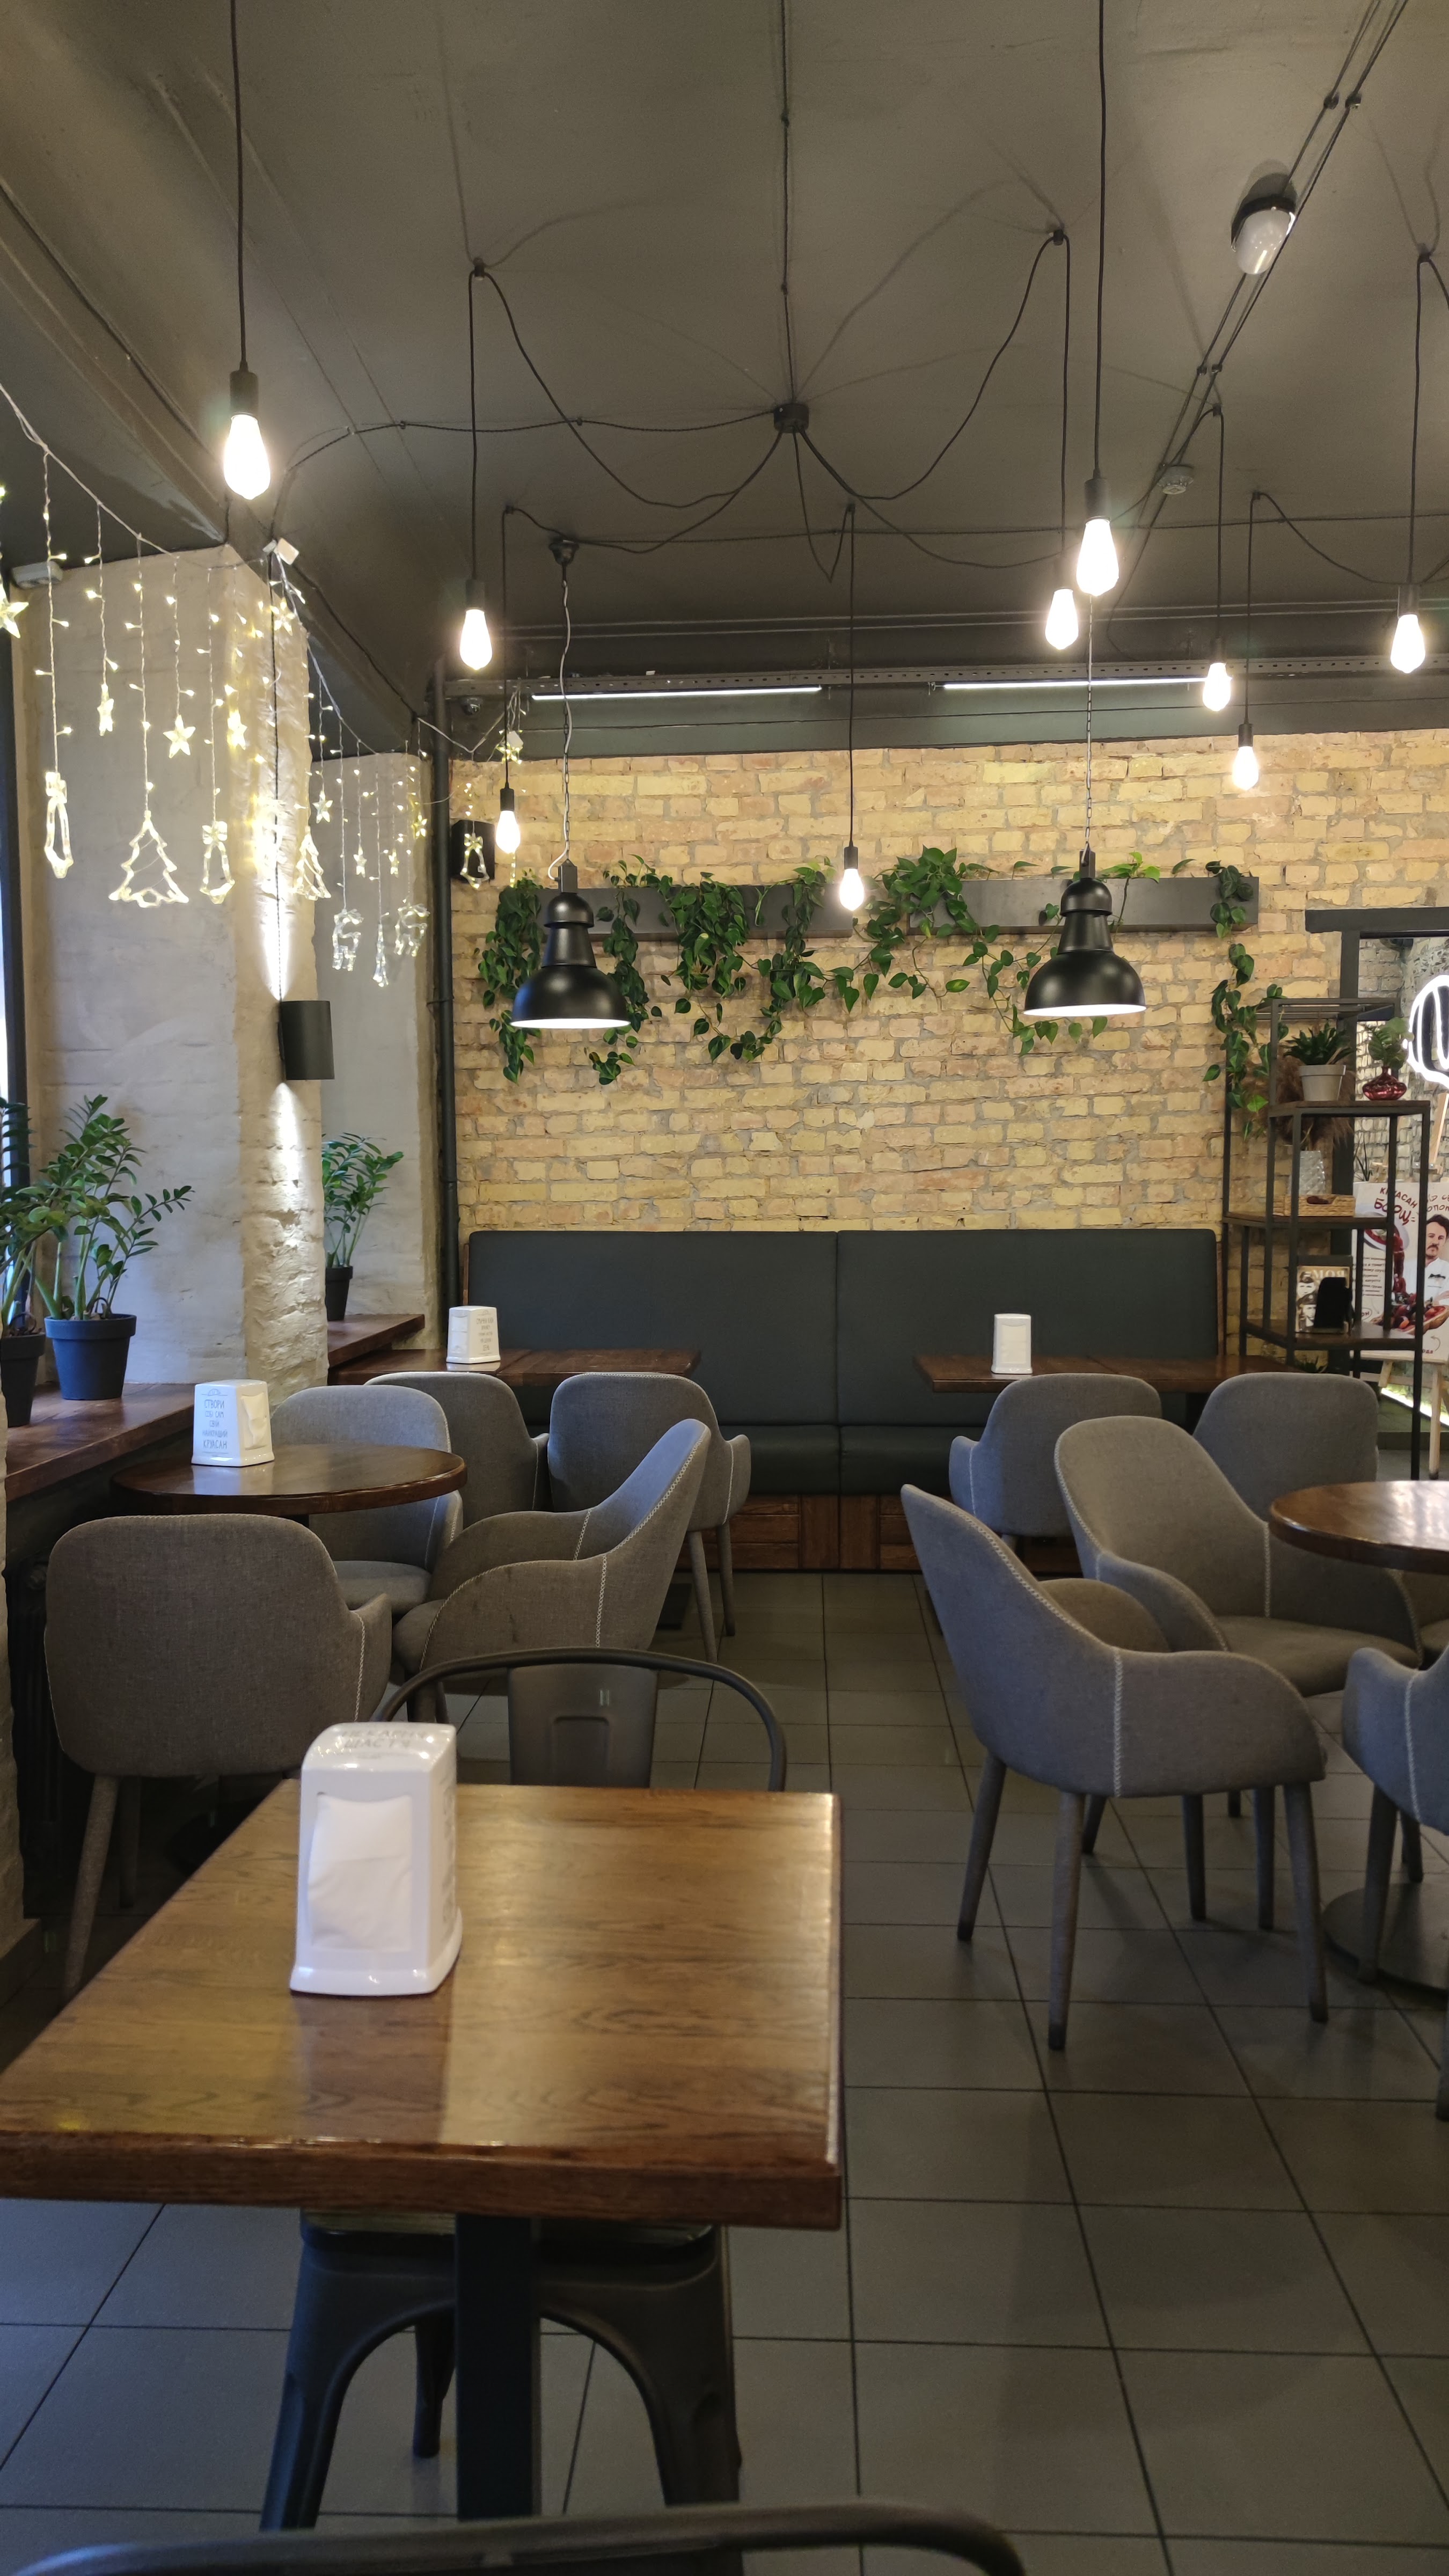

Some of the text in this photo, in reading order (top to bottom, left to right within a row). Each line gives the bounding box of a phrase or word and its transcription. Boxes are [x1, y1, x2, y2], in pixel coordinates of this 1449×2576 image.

[1380, 1187, 1418, 1209] КАСАН
[204, 1399, 224, 1409] СТВОРИ
[203, 1440, 228, 1449] КРУАСАН
